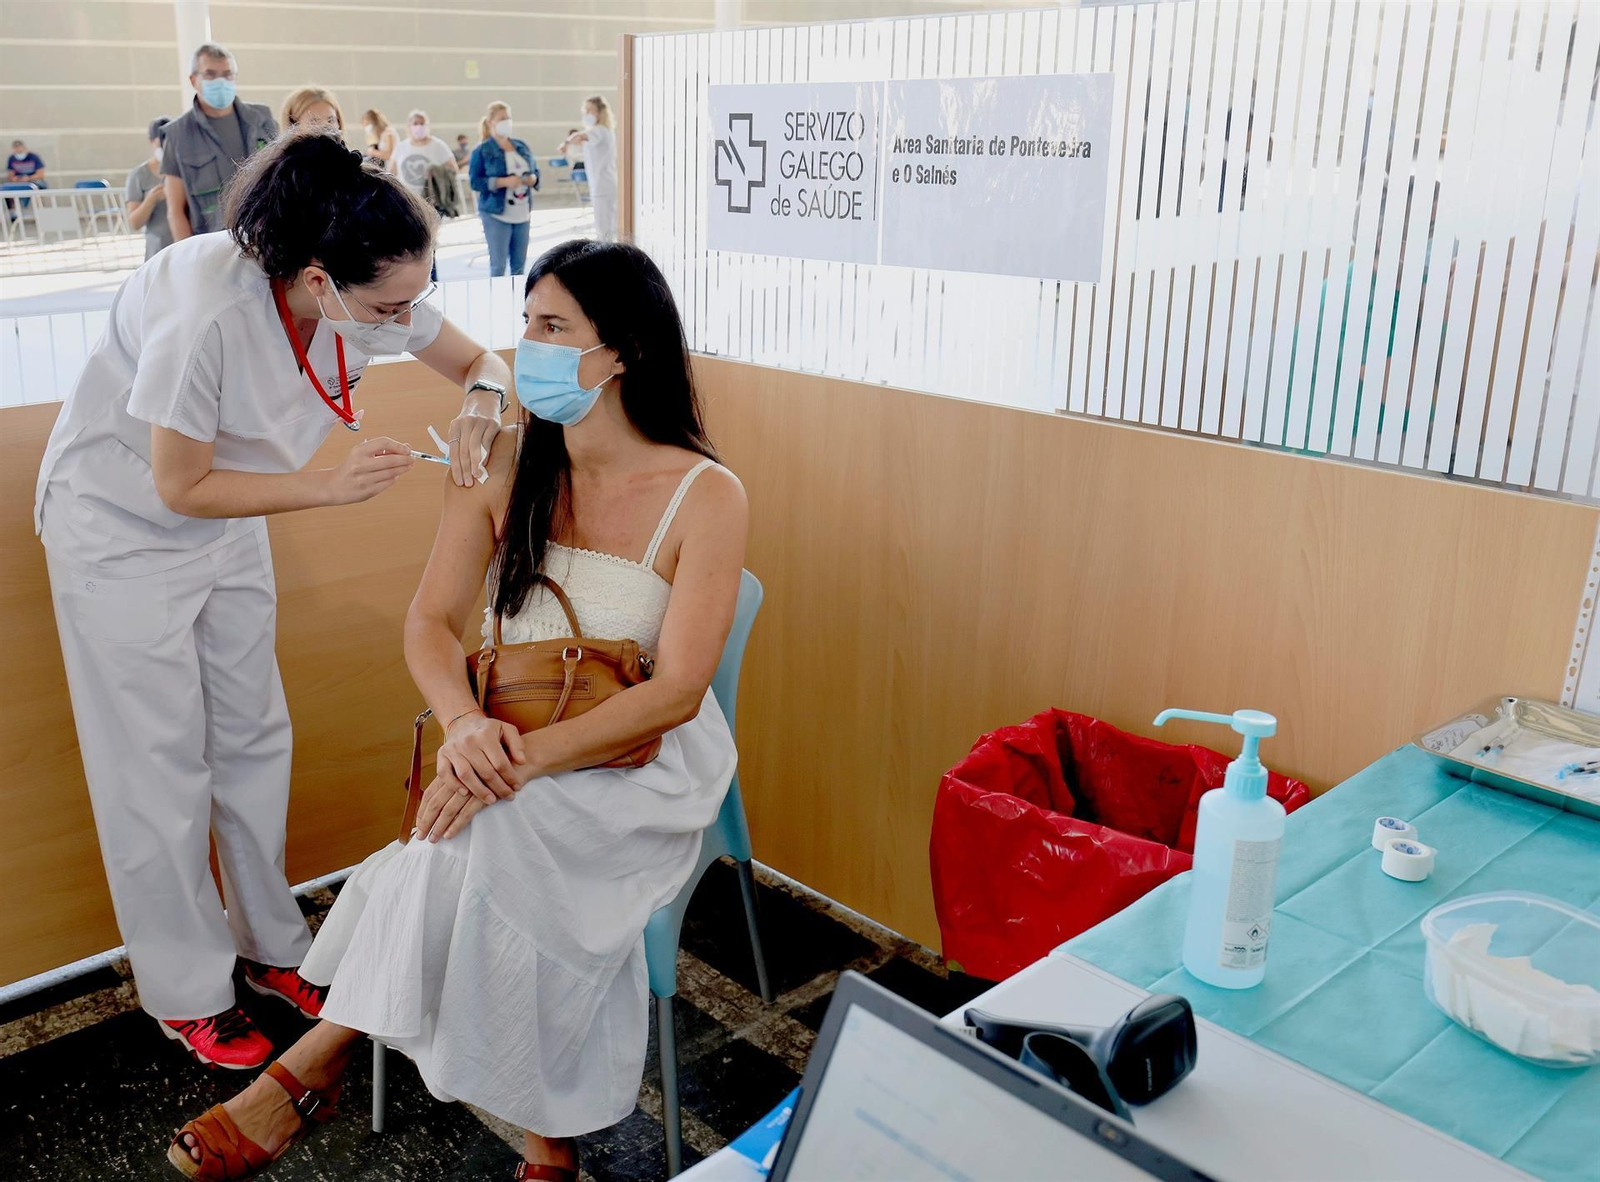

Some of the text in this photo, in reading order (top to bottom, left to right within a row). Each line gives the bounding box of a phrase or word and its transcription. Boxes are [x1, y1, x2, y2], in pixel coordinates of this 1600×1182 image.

[784, 112, 865, 141] SERVIZO
[925, 134, 984, 156] Sanitaria
[989, 135, 1006, 156] de
[780, 150, 863, 181] GALEGO
[892, 164, 957, 186] e O Salnés
[771, 183, 862, 220] de SAÚDE
